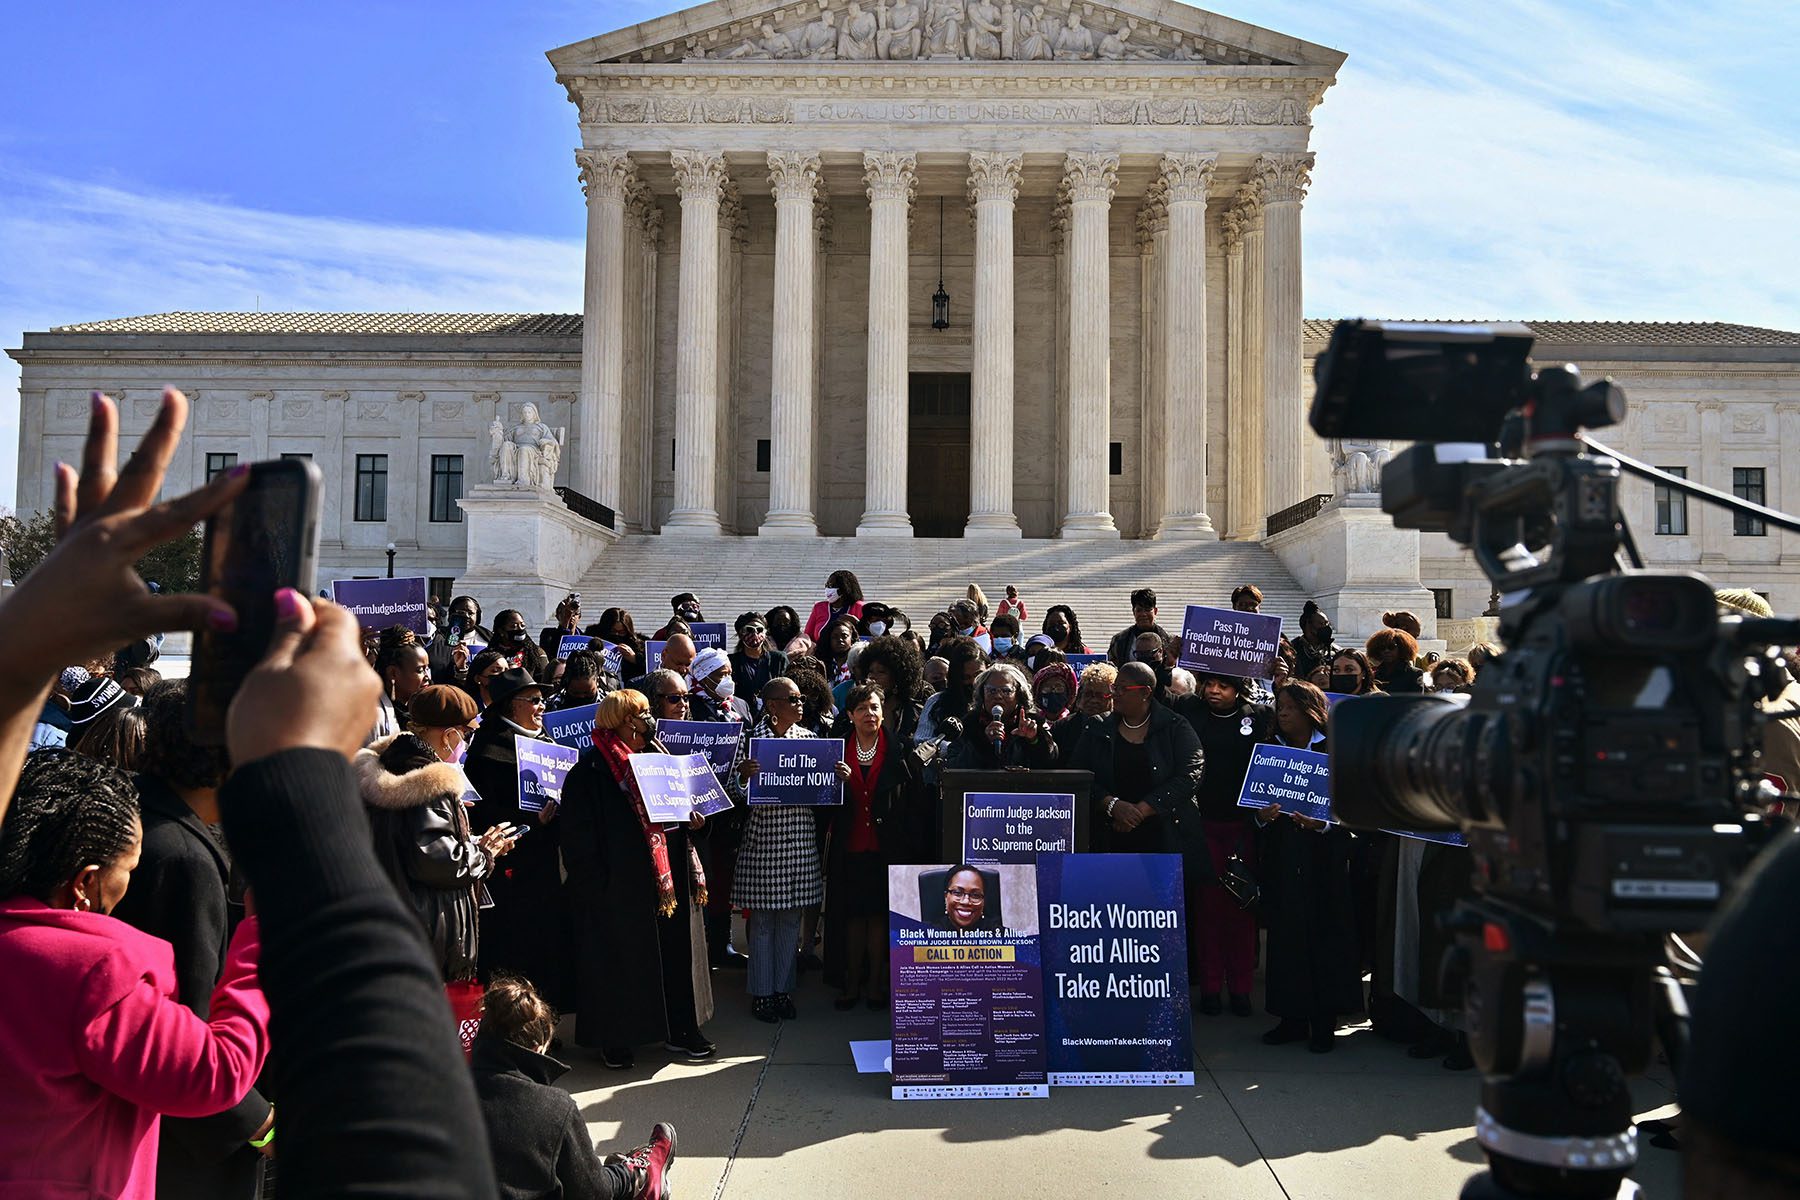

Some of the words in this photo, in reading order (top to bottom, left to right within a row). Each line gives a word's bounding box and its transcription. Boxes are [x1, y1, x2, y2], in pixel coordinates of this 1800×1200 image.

[807, 104, 872, 120] EQUAL
[881, 104, 958, 120] JUSTICE
[967, 104, 1034, 120] UNDER
[1041, 104, 1081, 120] LAW
[1213, 620, 1233, 633] Pass
[1235, 622, 1250, 635] The
[699, 633, 721, 643] YOUTH
[1185, 629, 1221, 644] Freedom
[1222, 634, 1231, 646] to
[1233, 635, 1254, 648] Vote:
[1254, 640, 1275, 652] John
[1189, 642, 1198, 654] R.
[1200, 644, 1223, 657] Lewis
[1224, 647, 1239, 660] Act
[1240, 650, 1265, 663] NOW!
[553, 722, 585, 739] BLACK
[658, 731, 691, 744] Confirm
[692, 733, 714, 746] Judge
[715, 734, 739, 745] Jackson
[779, 754, 797, 768] End
[799, 754, 817, 768] The
[1253, 754, 1287, 768] Confirm
[1287, 758, 1313, 774] Judge
[759, 772, 805, 786] Filibuster
[807, 772, 835, 786] NOW!
[1282, 772, 1293, 784] to
[1294, 775, 1309, 787] the
[523, 781, 536, 795] U.S.
[1250, 781, 1266, 794] U.S.
[1266, 783, 1306, 801] Supreme
[1306, 791, 1330, 806] Cour
[968, 805, 1005, 819] Confirm
[1006, 806, 1033, 820] Judge
[1034, 806, 1071, 819] Jackson
[1005, 823, 1016, 835] to
[1017, 822, 1033, 835] the
[972, 838, 990, 851] U.S.
[992, 838, 1033, 853] Supreme
[1035, 838, 1066, 852] Court!!
[1049, 903, 1102, 929] Black
[1106, 903, 1178, 929] Women
[900, 928, 925, 938] Black
[926, 928, 958, 938] Women
[959, 928, 994, 938] Leaders
[995, 928, 1002, 938] &
[1003, 928, 1028, 938] Allies
[926, 948, 950, 960] CALL
[952, 948, 965, 960] TO
[967, 948, 1003, 960] ACTION
[1069, 938, 1104, 963] and
[1109, 938, 1161, 963] Allies
[1054, 973, 1100, 999] Take
[1105, 973, 1171, 999] Action!
[1062, 1037, 1172, 1047] BlackWomenTakeAction.org
